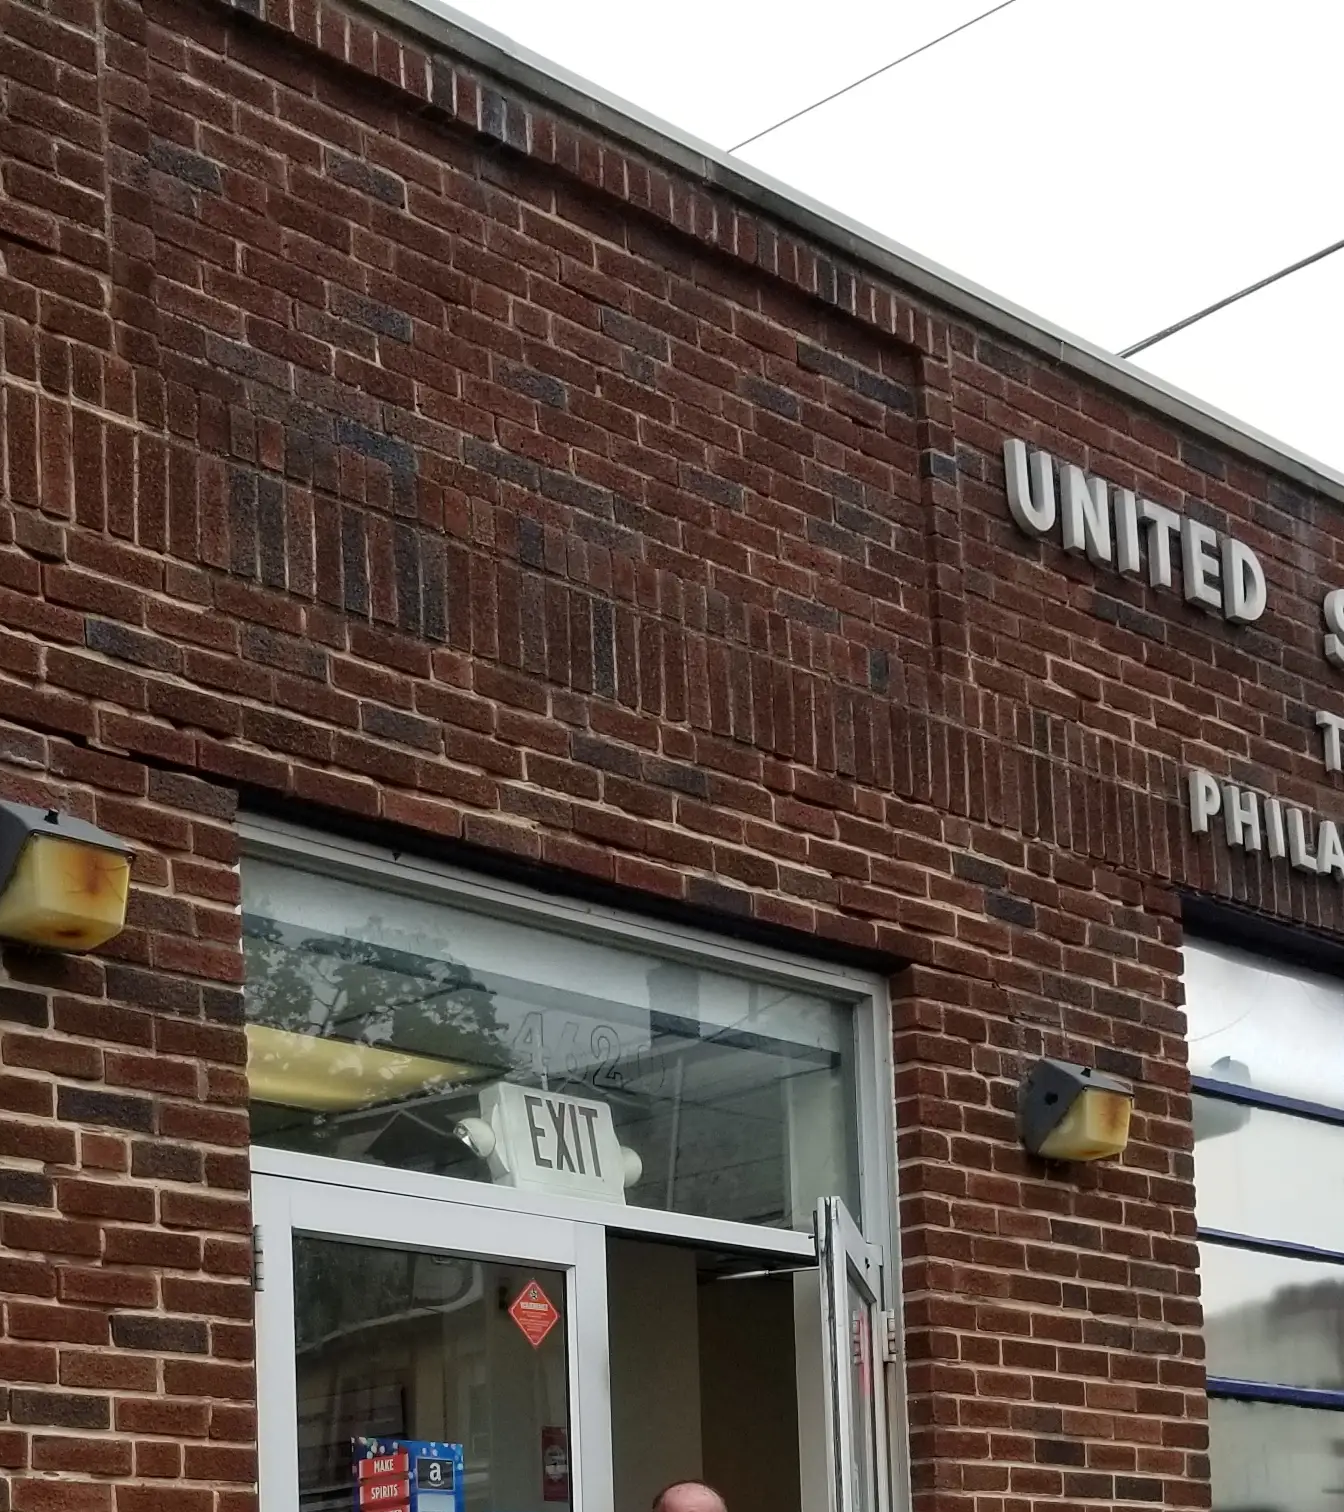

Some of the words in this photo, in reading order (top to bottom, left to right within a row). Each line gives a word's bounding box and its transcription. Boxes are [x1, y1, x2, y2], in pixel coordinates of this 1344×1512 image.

[1003, 439, 1268, 625] UNITED
[523, 1094, 602, 1178] EXIT
[374, 1459, 394, 1474] MAKE
[371, 1484, 398, 1500] SPIRITS
